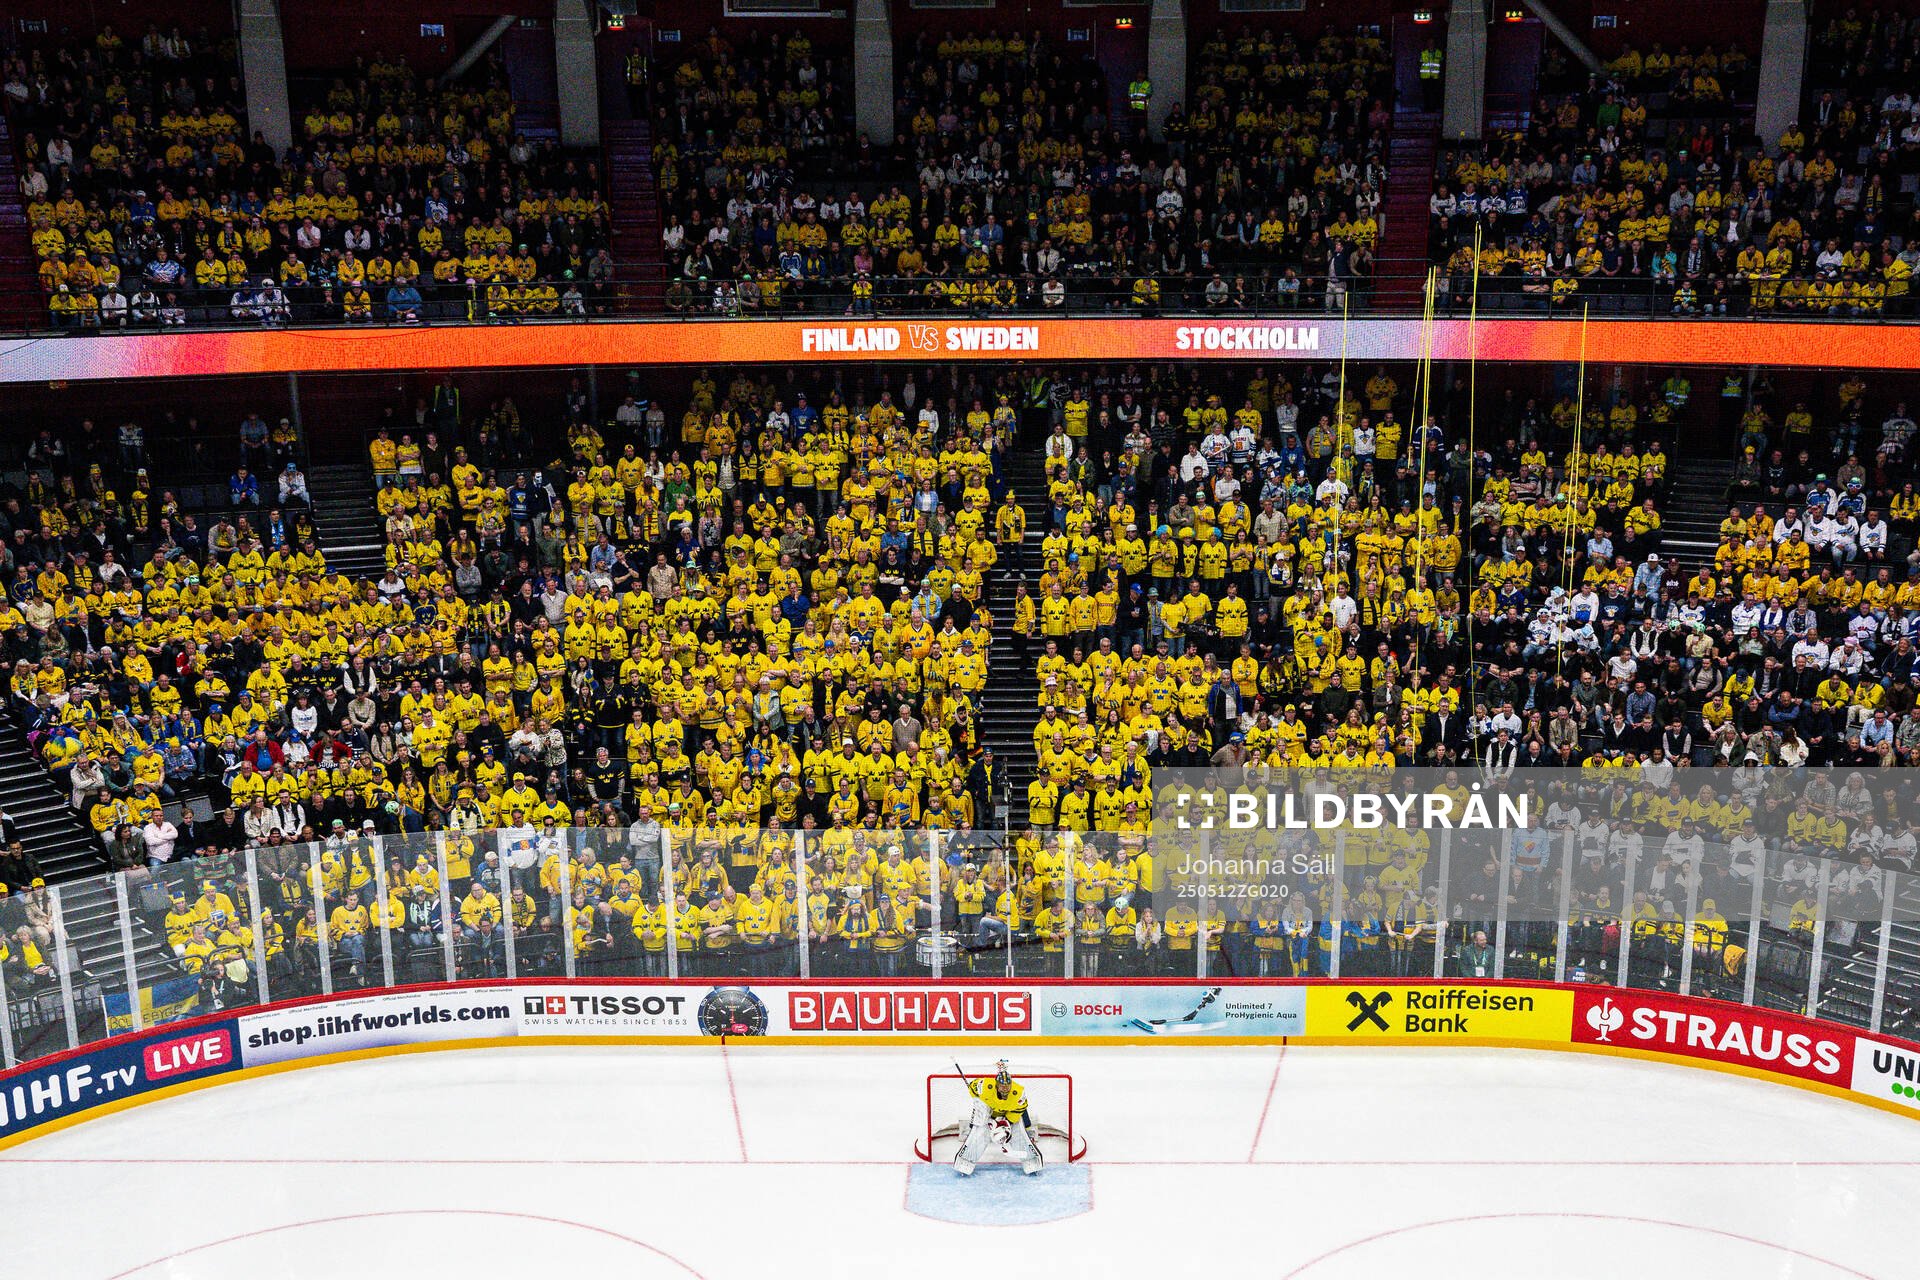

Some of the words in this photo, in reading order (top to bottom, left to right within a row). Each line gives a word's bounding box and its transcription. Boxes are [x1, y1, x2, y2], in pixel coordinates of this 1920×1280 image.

[802, 327, 900, 353] FINLAND
[908, 324, 940, 352] VS
[945, 326, 1040, 352] SWEDEN
[1176, 326, 1320, 351] STOCKHOLM
[570, 996, 685, 1015] TISSOT
[1073, 1004, 1123, 1016] BOSCH
[1225, 1002, 1266, 1010] Unlimited
[1267, 1002, 1273, 1010] 7
[1406, 989, 1534, 1012] Raiffeisen
[246, 1003, 511, 1048] shop.iihfworlds.com
[1225, 1011, 1274, 1020] ProHygienic
[1276, 1011, 1298, 1020] Aqua
[1405, 1013, 1469, 1033] Bank
[1630, 1006, 1841, 1075] STRAUSS
[151, 1035, 224, 1074] LIVE
